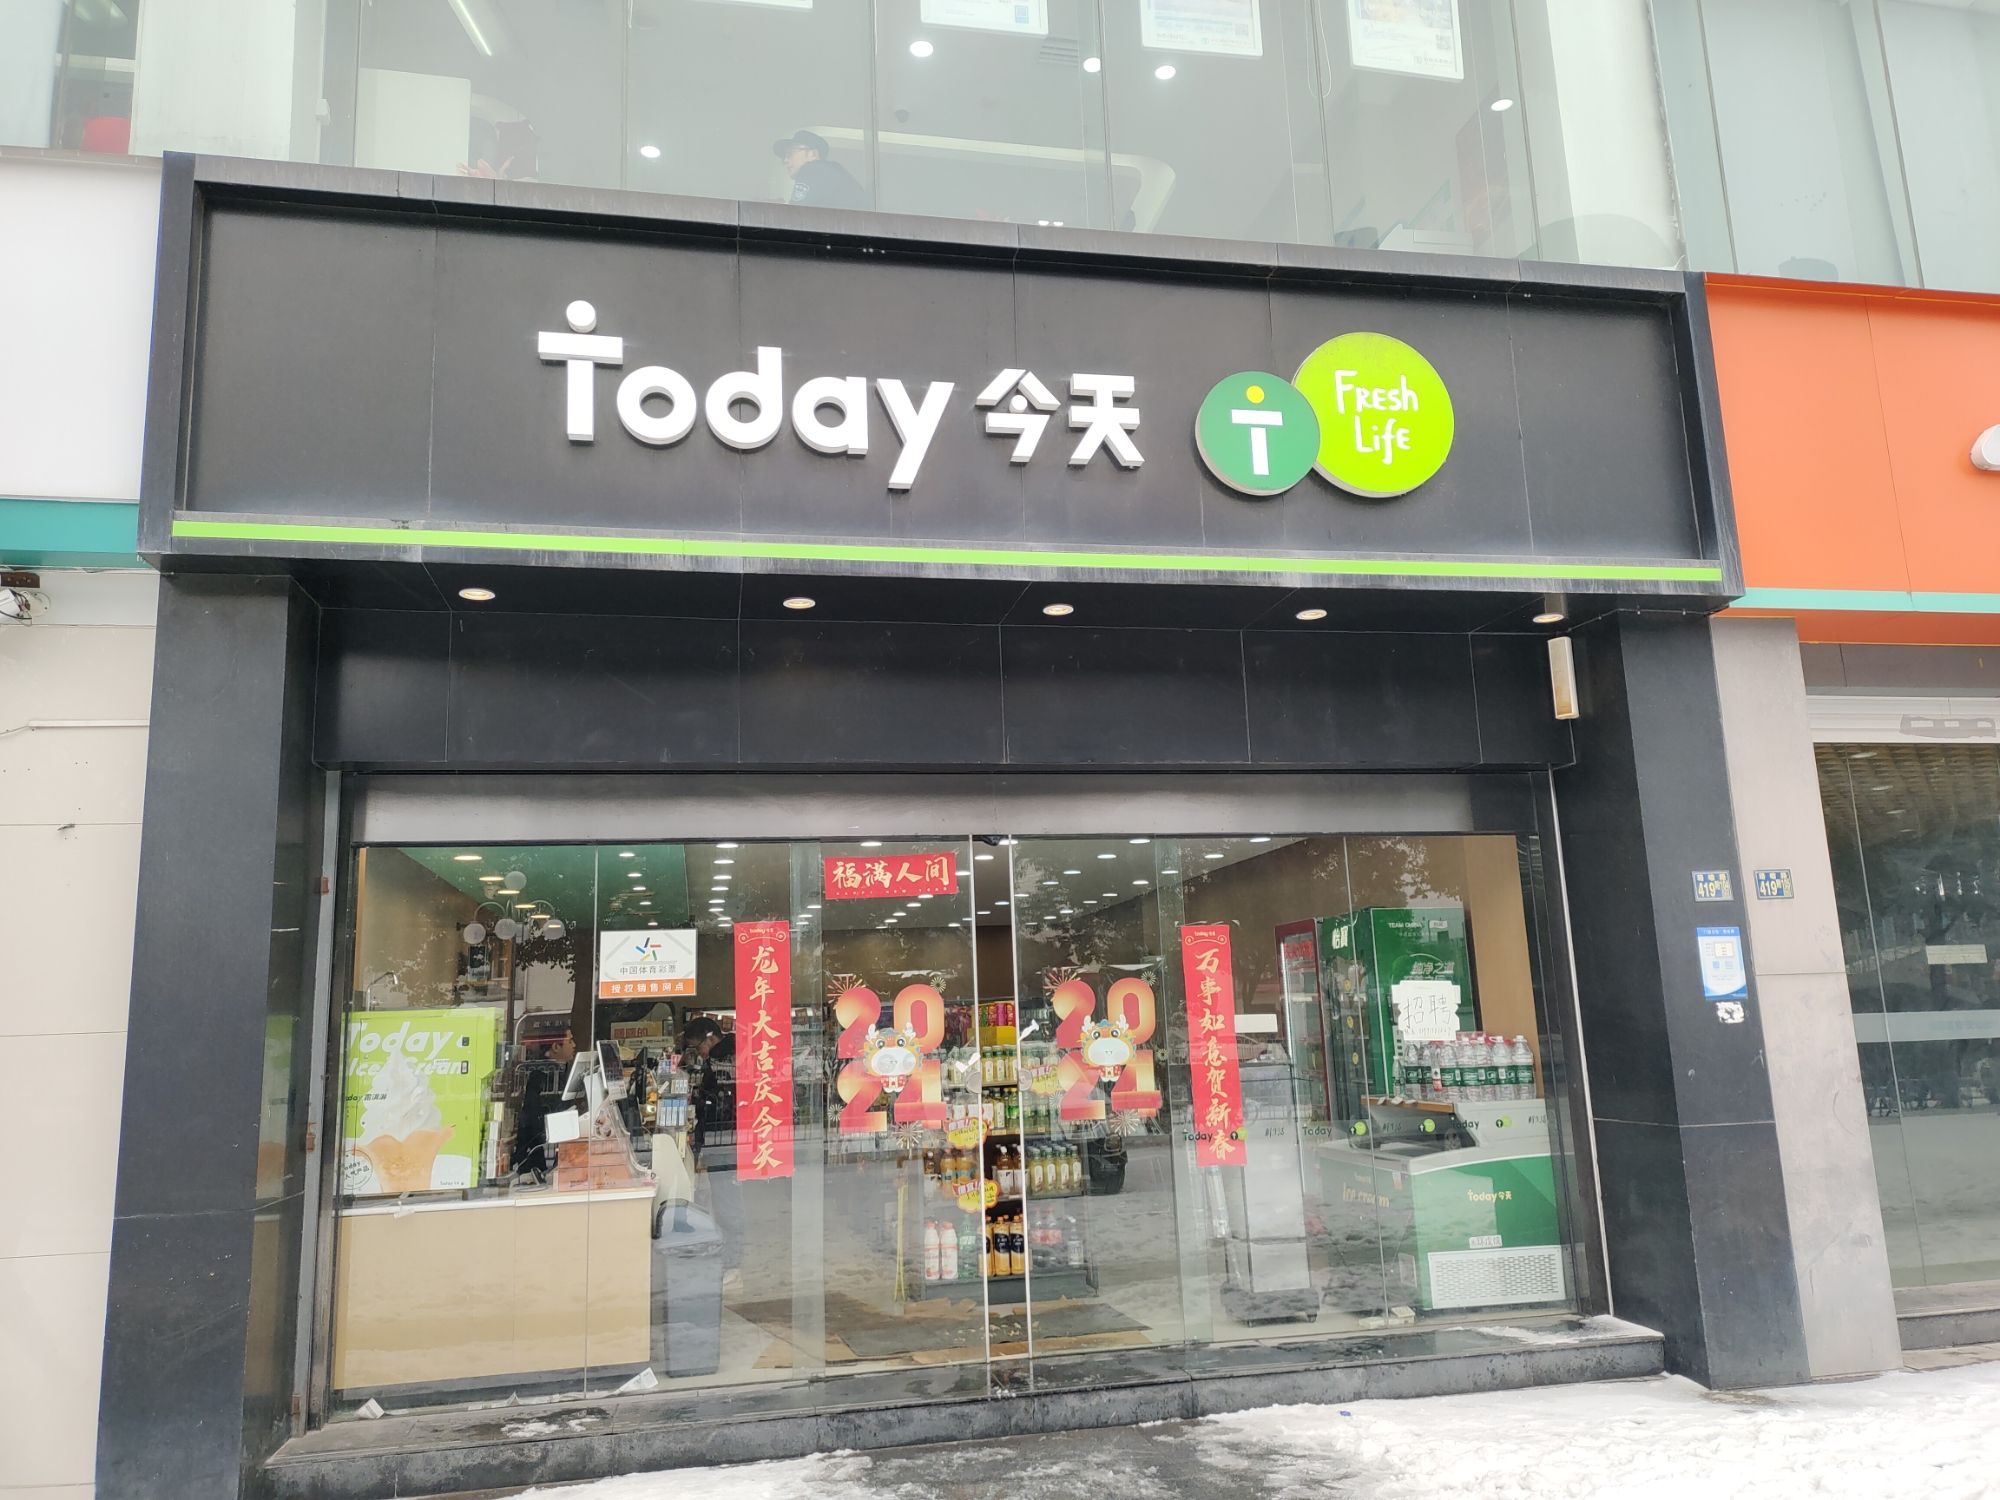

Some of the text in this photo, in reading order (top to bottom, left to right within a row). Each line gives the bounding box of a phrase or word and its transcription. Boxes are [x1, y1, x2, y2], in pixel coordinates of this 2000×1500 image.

[538, 300, 1146, 490] Today 今天
[831, 857, 950, 889] 福满人间
[619, 965, 677, 975] 中国体育彩票
[611, 983, 684, 993] 授权销售网点
[1402, 993, 1451, 1028] 招聘
[348, 1021, 454, 1061] Today
[1195, 948, 1236, 1161] 万事如意贺新春
[749, 945, 784, 1171] 龙年大吉庆今天
[1182, 1128, 1213, 1143] Today
[1302, 1124, 1333, 1137] Today
